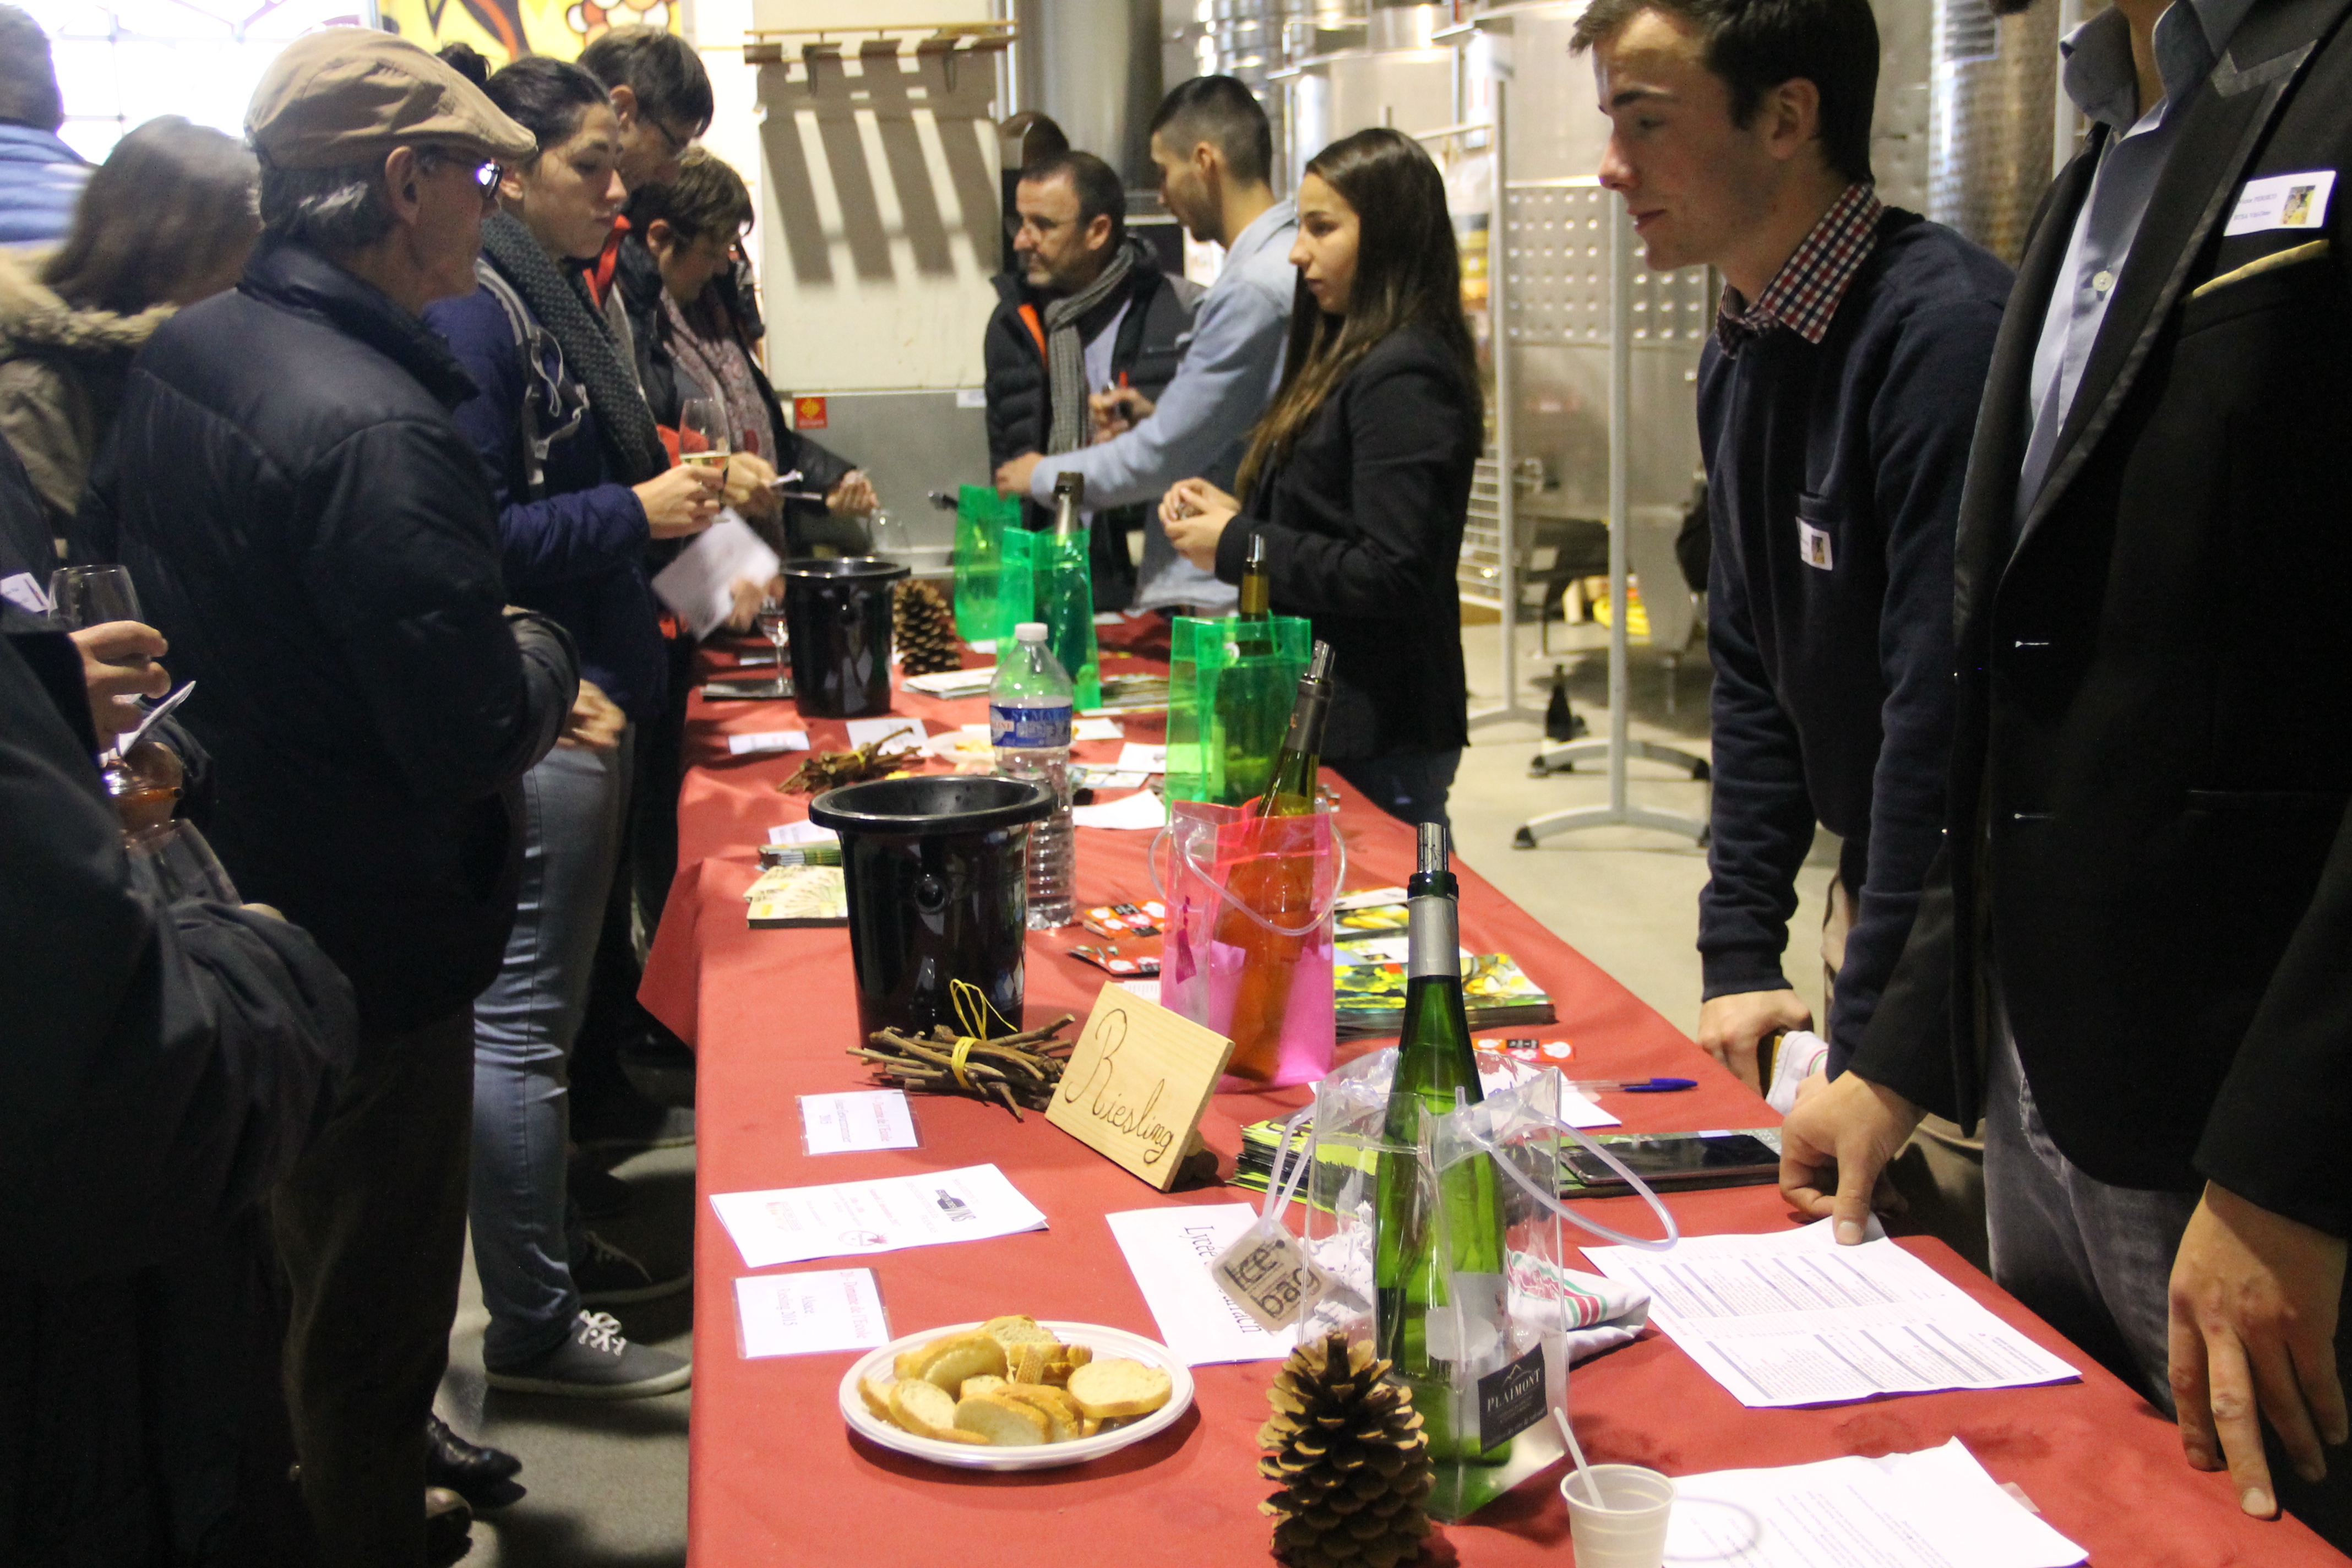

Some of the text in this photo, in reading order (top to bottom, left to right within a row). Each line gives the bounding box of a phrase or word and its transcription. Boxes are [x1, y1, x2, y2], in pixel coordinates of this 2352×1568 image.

[1065, 1008, 1174, 1165] Riesling
[1178, 1226, 1225, 1257] Lycée
[776, 1288, 798, 1326] Riesling 2015
[801, 1295, 816, 1314] Alsace
[843, 1282, 862, 1305] Domaine
[1250, 1265, 1321, 1319] bag
[1487, 1368, 1540, 1412] PLAIMONT
